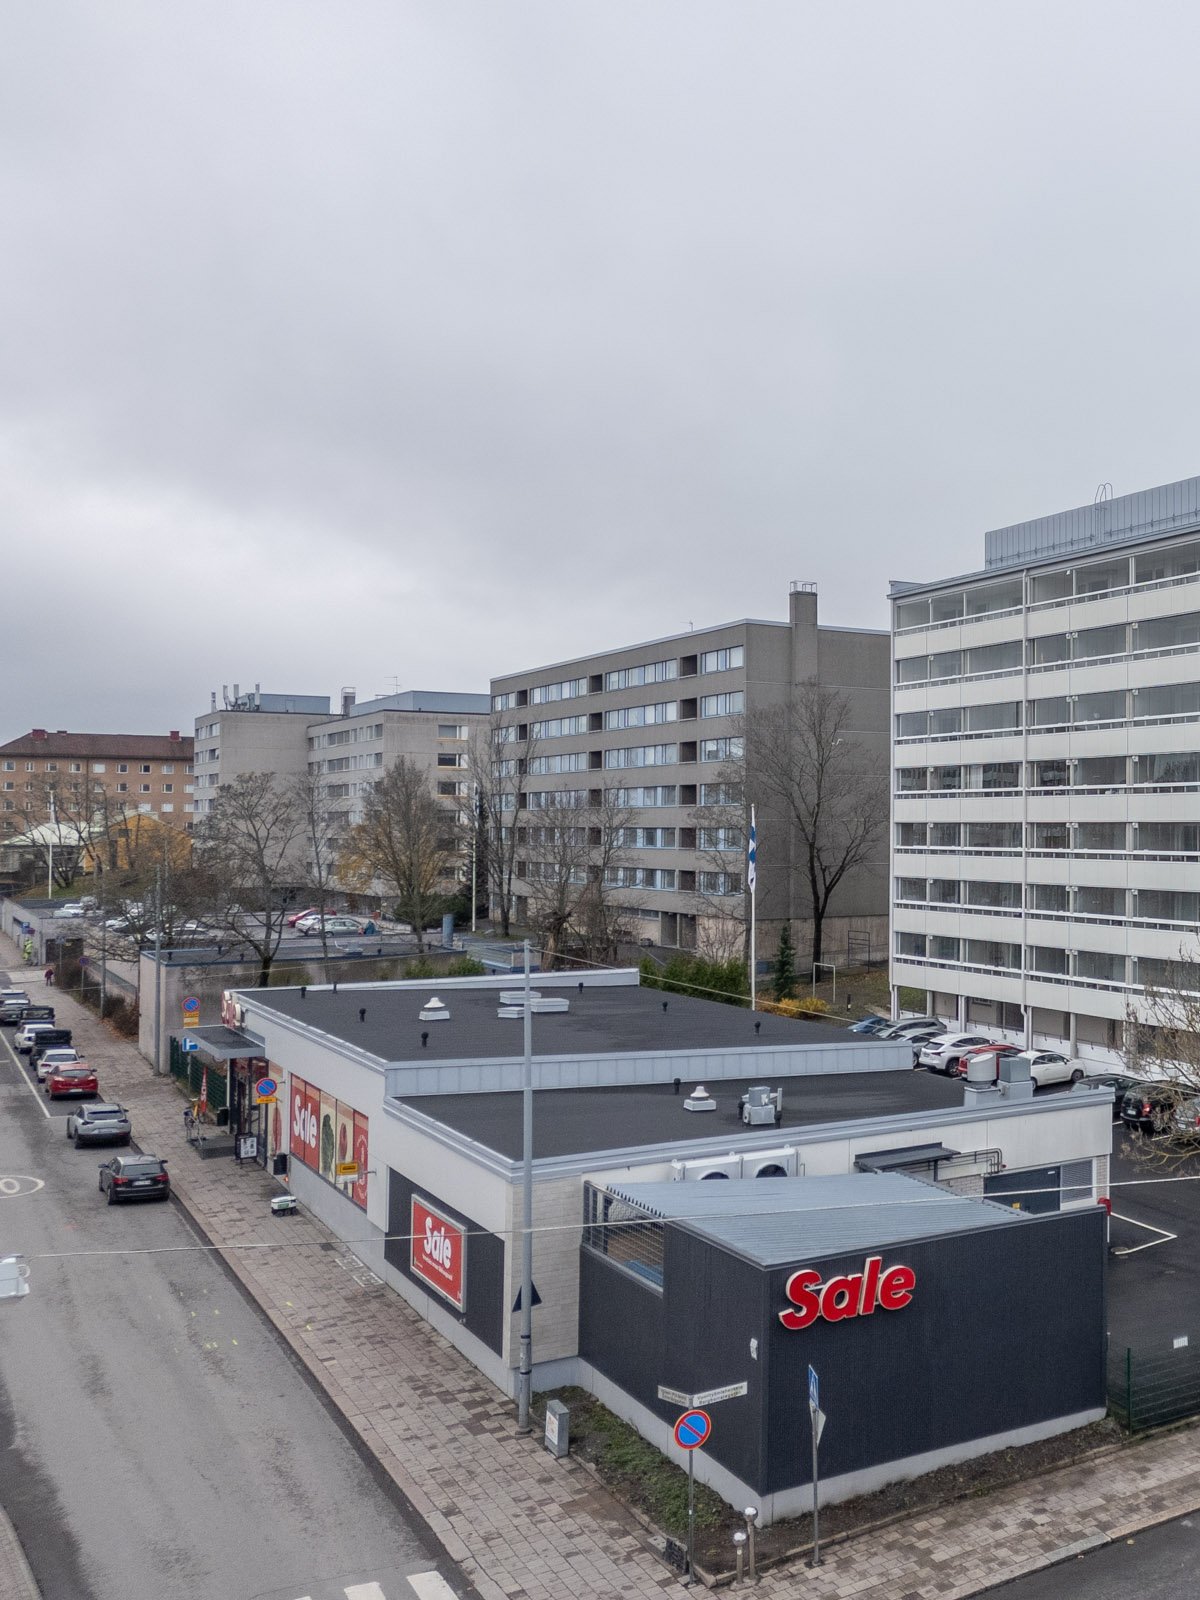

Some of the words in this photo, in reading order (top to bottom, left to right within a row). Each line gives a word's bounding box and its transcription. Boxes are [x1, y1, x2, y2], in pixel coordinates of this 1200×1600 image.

[293, 1094, 317, 1148] Sale
[424, 1216, 452, 1269] Sale
[779, 1256, 916, 1330] Sale
